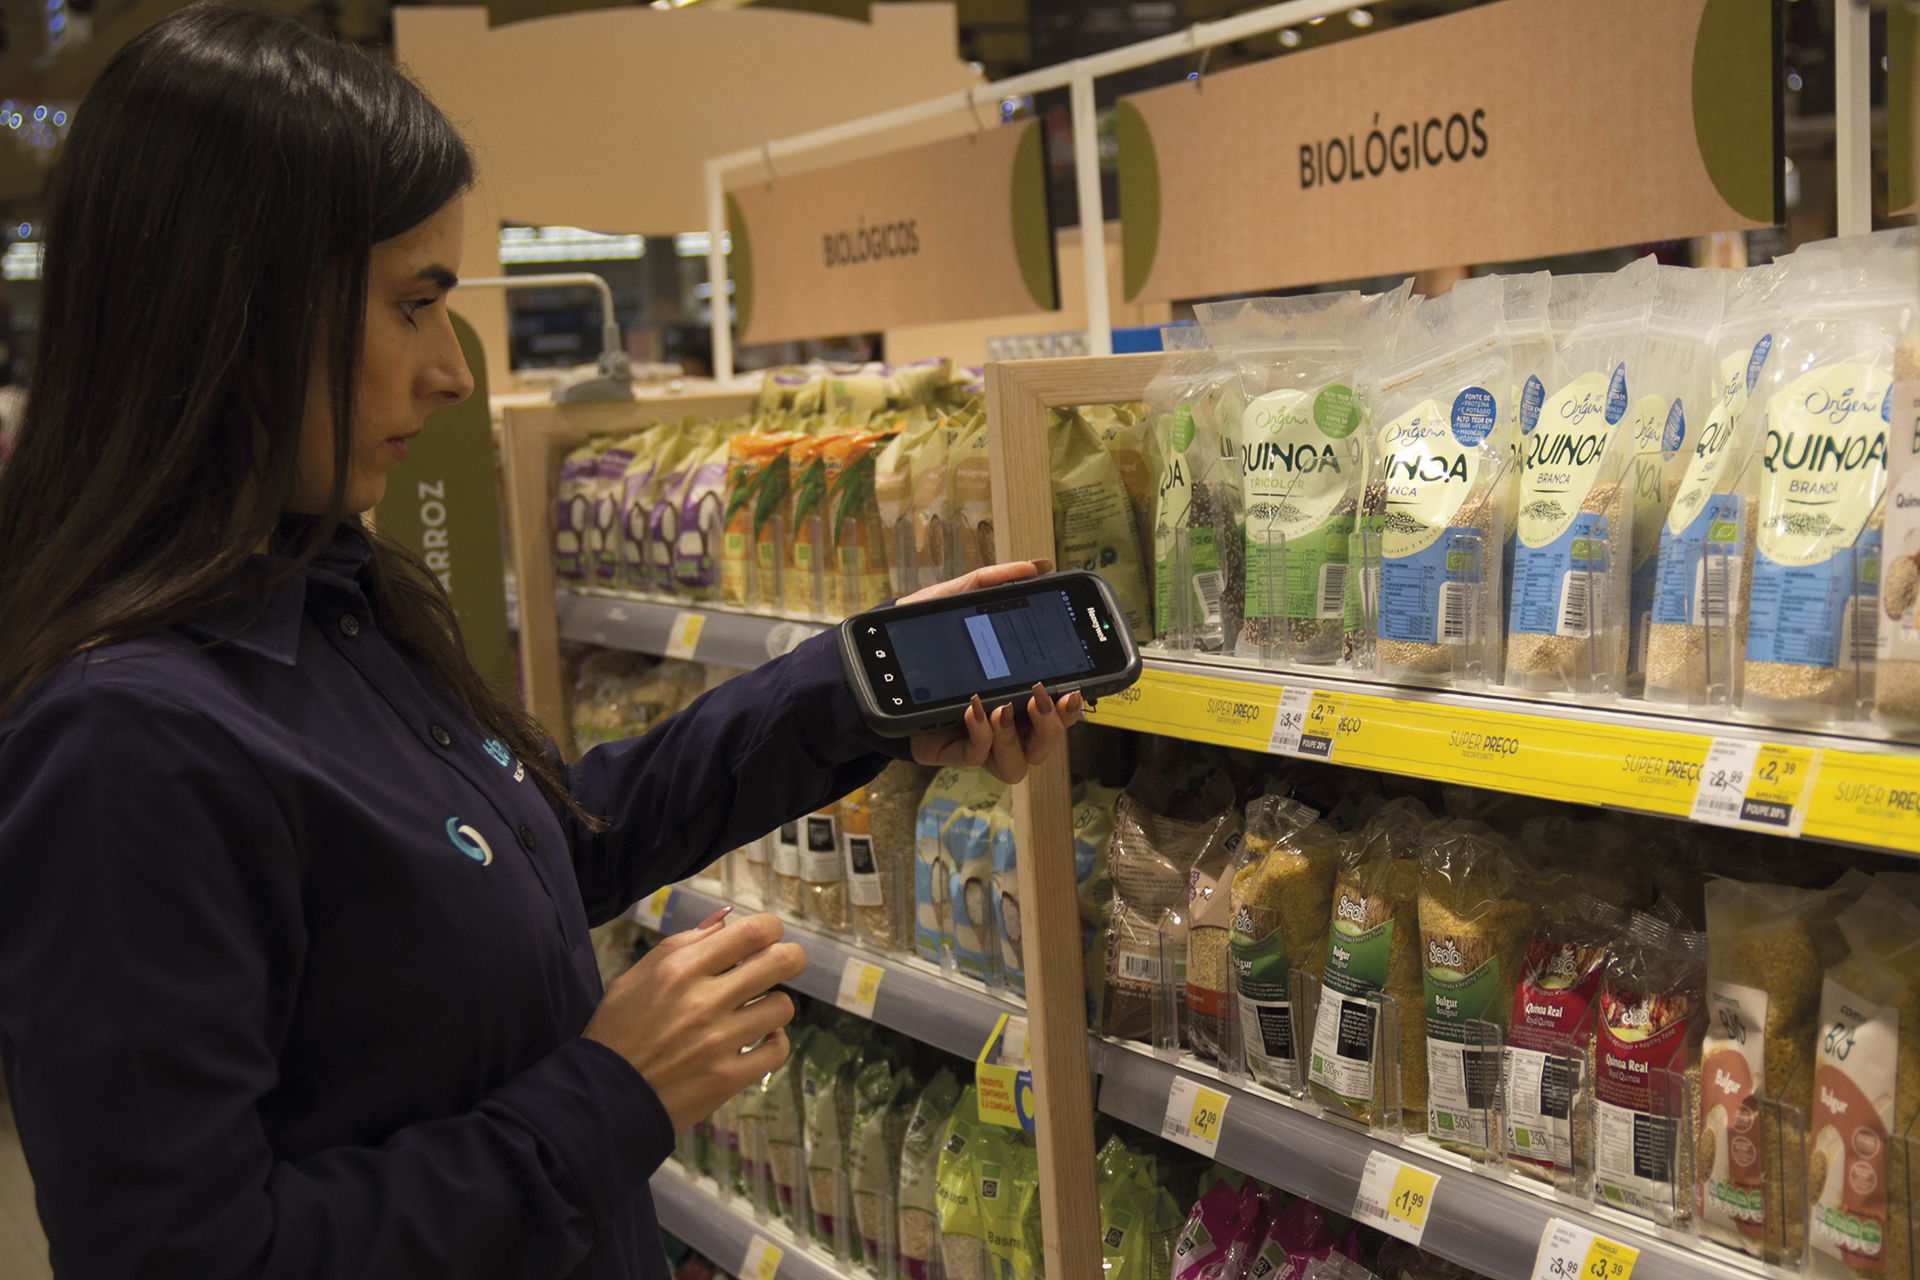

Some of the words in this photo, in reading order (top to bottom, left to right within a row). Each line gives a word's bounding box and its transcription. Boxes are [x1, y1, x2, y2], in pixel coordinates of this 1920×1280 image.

[1299, 107, 1489, 190] BIOLÓGICOS
[823, 217, 920, 268] BIOLÓGICOS
[1465, 393, 1482, 401] FONTE
[1384, 453, 1467, 483] INOA
[1250, 477, 1304, 490] TRICOLOR
[1536, 473, 1572, 485] BRANCA
[1789, 479, 1839, 494] BRANCA
[1896, 493, 1920, 508] Quin
[418, 480, 453, 593] ARROZ
[1087, 607, 1107, 642] Honeywell
[1206, 699, 1232, 716] SUPER
[1233, 703, 1260, 723] PREÇO
[1302, 739, 1317, 748] POUPE
[1317, 742, 1327, 750] 20%
[1448, 730, 1482, 750] SUPER
[1483, 736, 1519, 758] PREÇO
[1622, 754, 1663, 775] SUPER
[1834, 781, 1886, 807] SUPER
[1745, 804, 1770, 816] POUPE
[1771, 807, 1786, 819] 20%
[1232, 957, 1253, 970] ulgur
[1435, 994, 1458, 1009] Bulgur
[1436, 1006, 1458, 1018] Boulgour
[1526, 1003, 1546, 1015] Quinoa
[1547, 1005, 1563, 1017] Real
[1538, 1018, 1555, 1028] Quinoa
[1661, 1028, 1676, 1040] food
[1606, 1053, 1627, 1070] Quinoa
[1628, 1059, 1649, 1073] Real
[1620, 1072, 1641, 1083] Quinoa
[1715, 1068, 1742, 1094] Bulgur
[1821, 1086, 1849, 1114] Bulgur
[988, 1230, 1027, 1250] Basm
[1595, 1242, 1618, 1255] PROMOÇÃO
